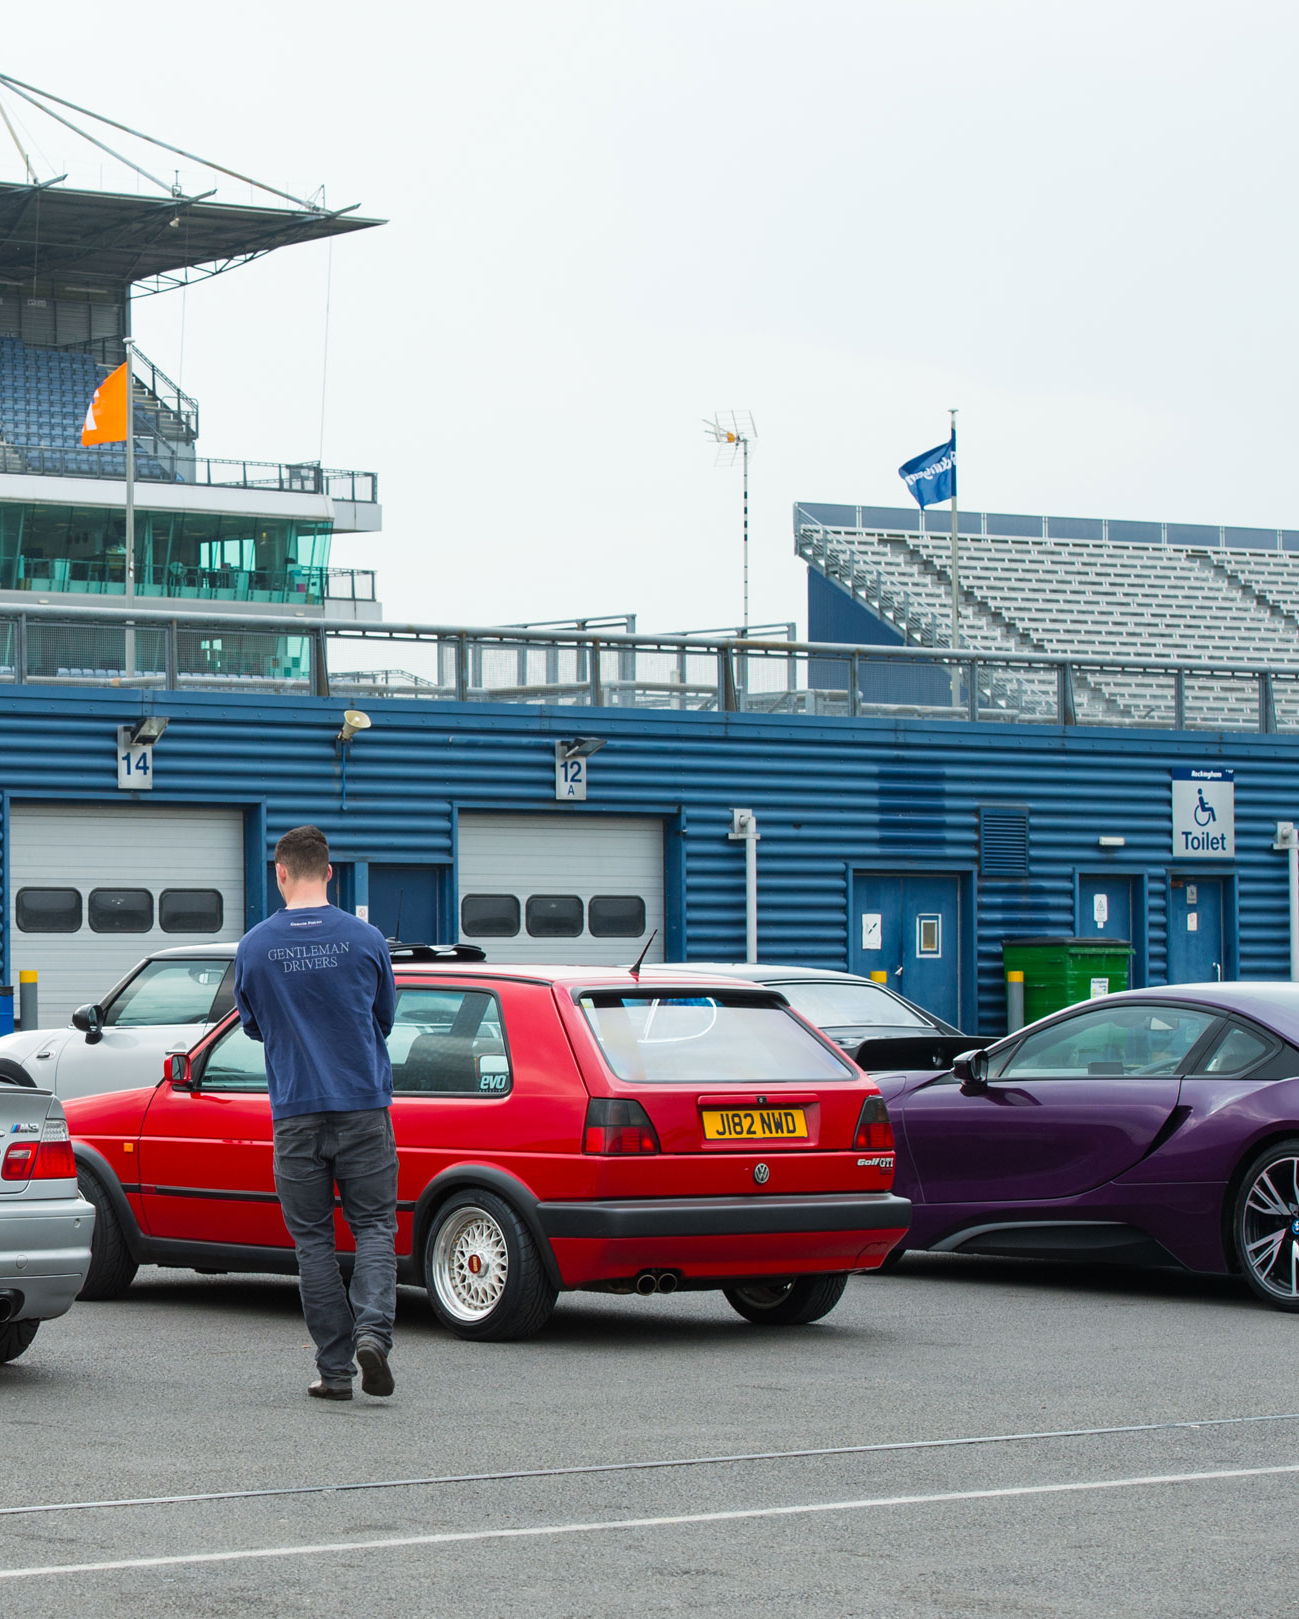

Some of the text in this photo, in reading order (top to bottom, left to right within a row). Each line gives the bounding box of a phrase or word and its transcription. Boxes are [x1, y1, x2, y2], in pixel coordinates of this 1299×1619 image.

[122, 752, 149, 775] 14
[560, 761, 582, 782] 12
[567, 785, 574, 795] A
[1181, 831, 1226, 850] Toilet
[268, 942, 349, 961] GENTLEMAN
[283, 957, 338, 973] DRIVERS
[480, 1075, 507, 1089] evo
[716, 1112, 796, 1135] J182 NWD
[879, 1157, 893, 1167] GTI
